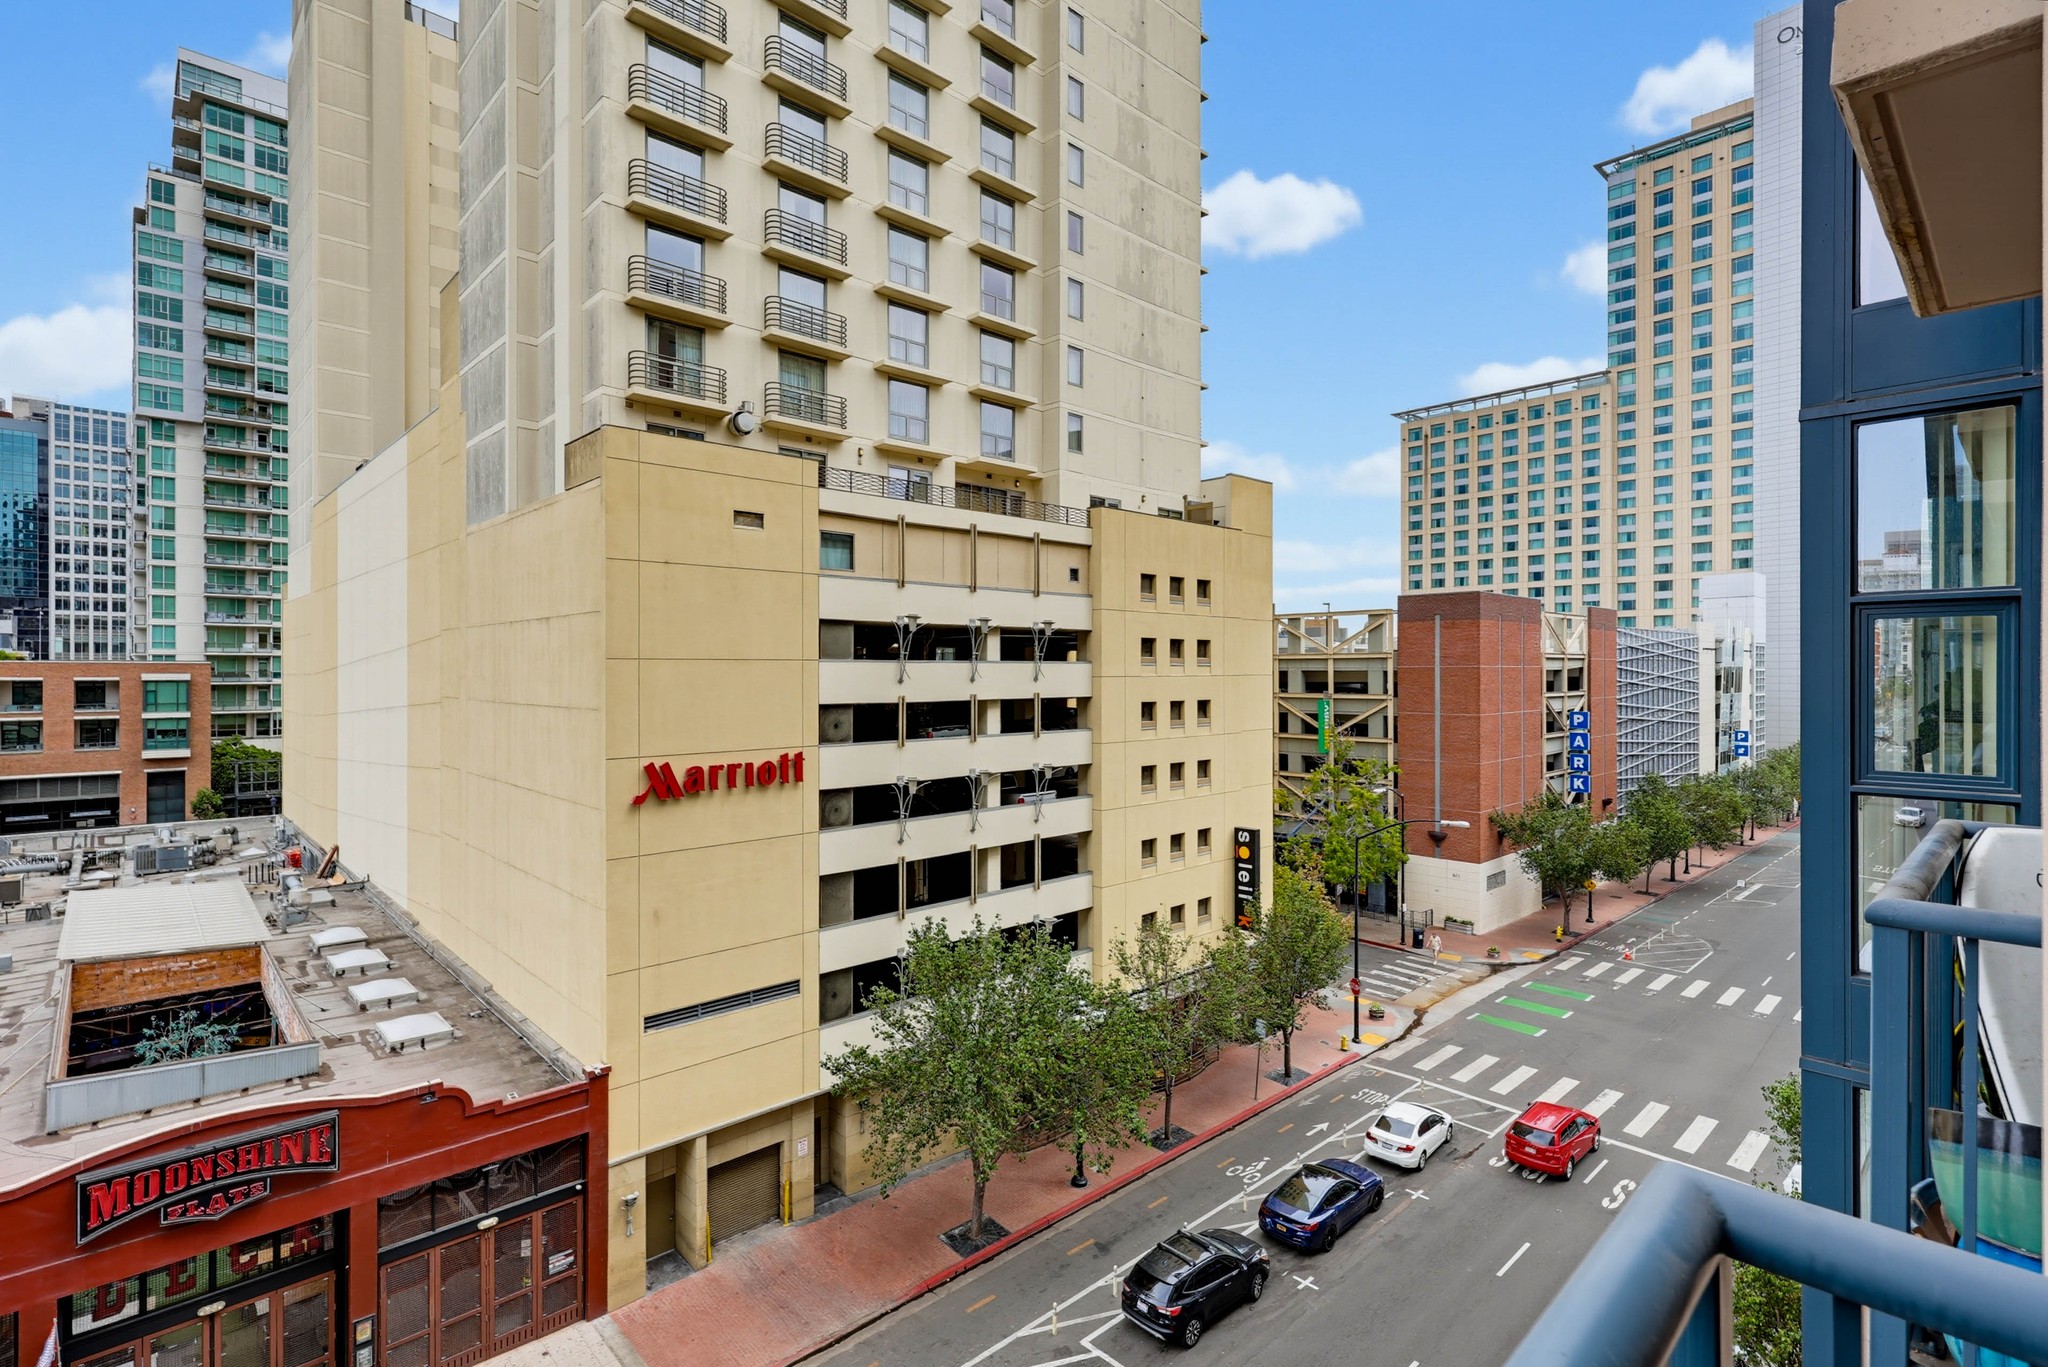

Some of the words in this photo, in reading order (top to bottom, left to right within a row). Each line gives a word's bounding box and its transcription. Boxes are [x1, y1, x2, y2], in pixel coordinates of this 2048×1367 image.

[1573, 714, 1585, 790] PARK
[1737, 732, 1746, 741] P
[630, 751, 805, 807] Marriott
[1350, 1088, 1390, 1106] STOP
[87, 1123, 331, 1230] MOONSHINE
[166, 1181, 267, 1220] FLATS
